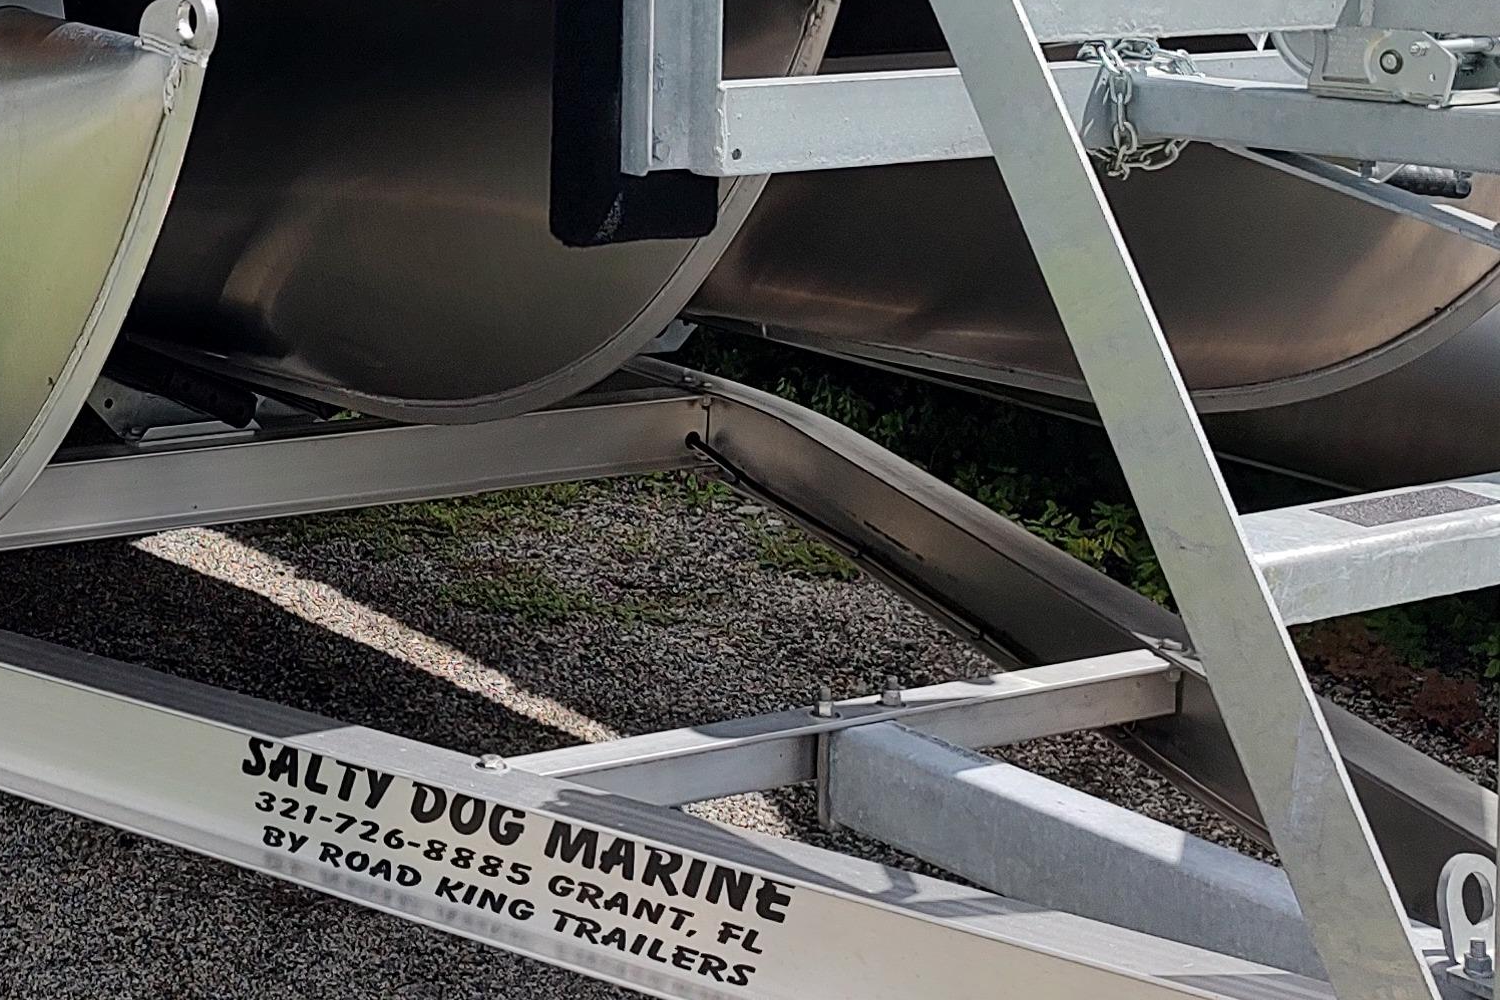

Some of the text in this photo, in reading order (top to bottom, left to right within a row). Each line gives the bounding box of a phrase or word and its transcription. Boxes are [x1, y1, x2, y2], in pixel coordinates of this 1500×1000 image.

[242, 736, 797, 923] SALTY DOG MARINE
[253, 790, 765, 956] 321-726-8885 GRANT, FL
[262, 825, 757, 989] BY ROAD KING TRAILERS
